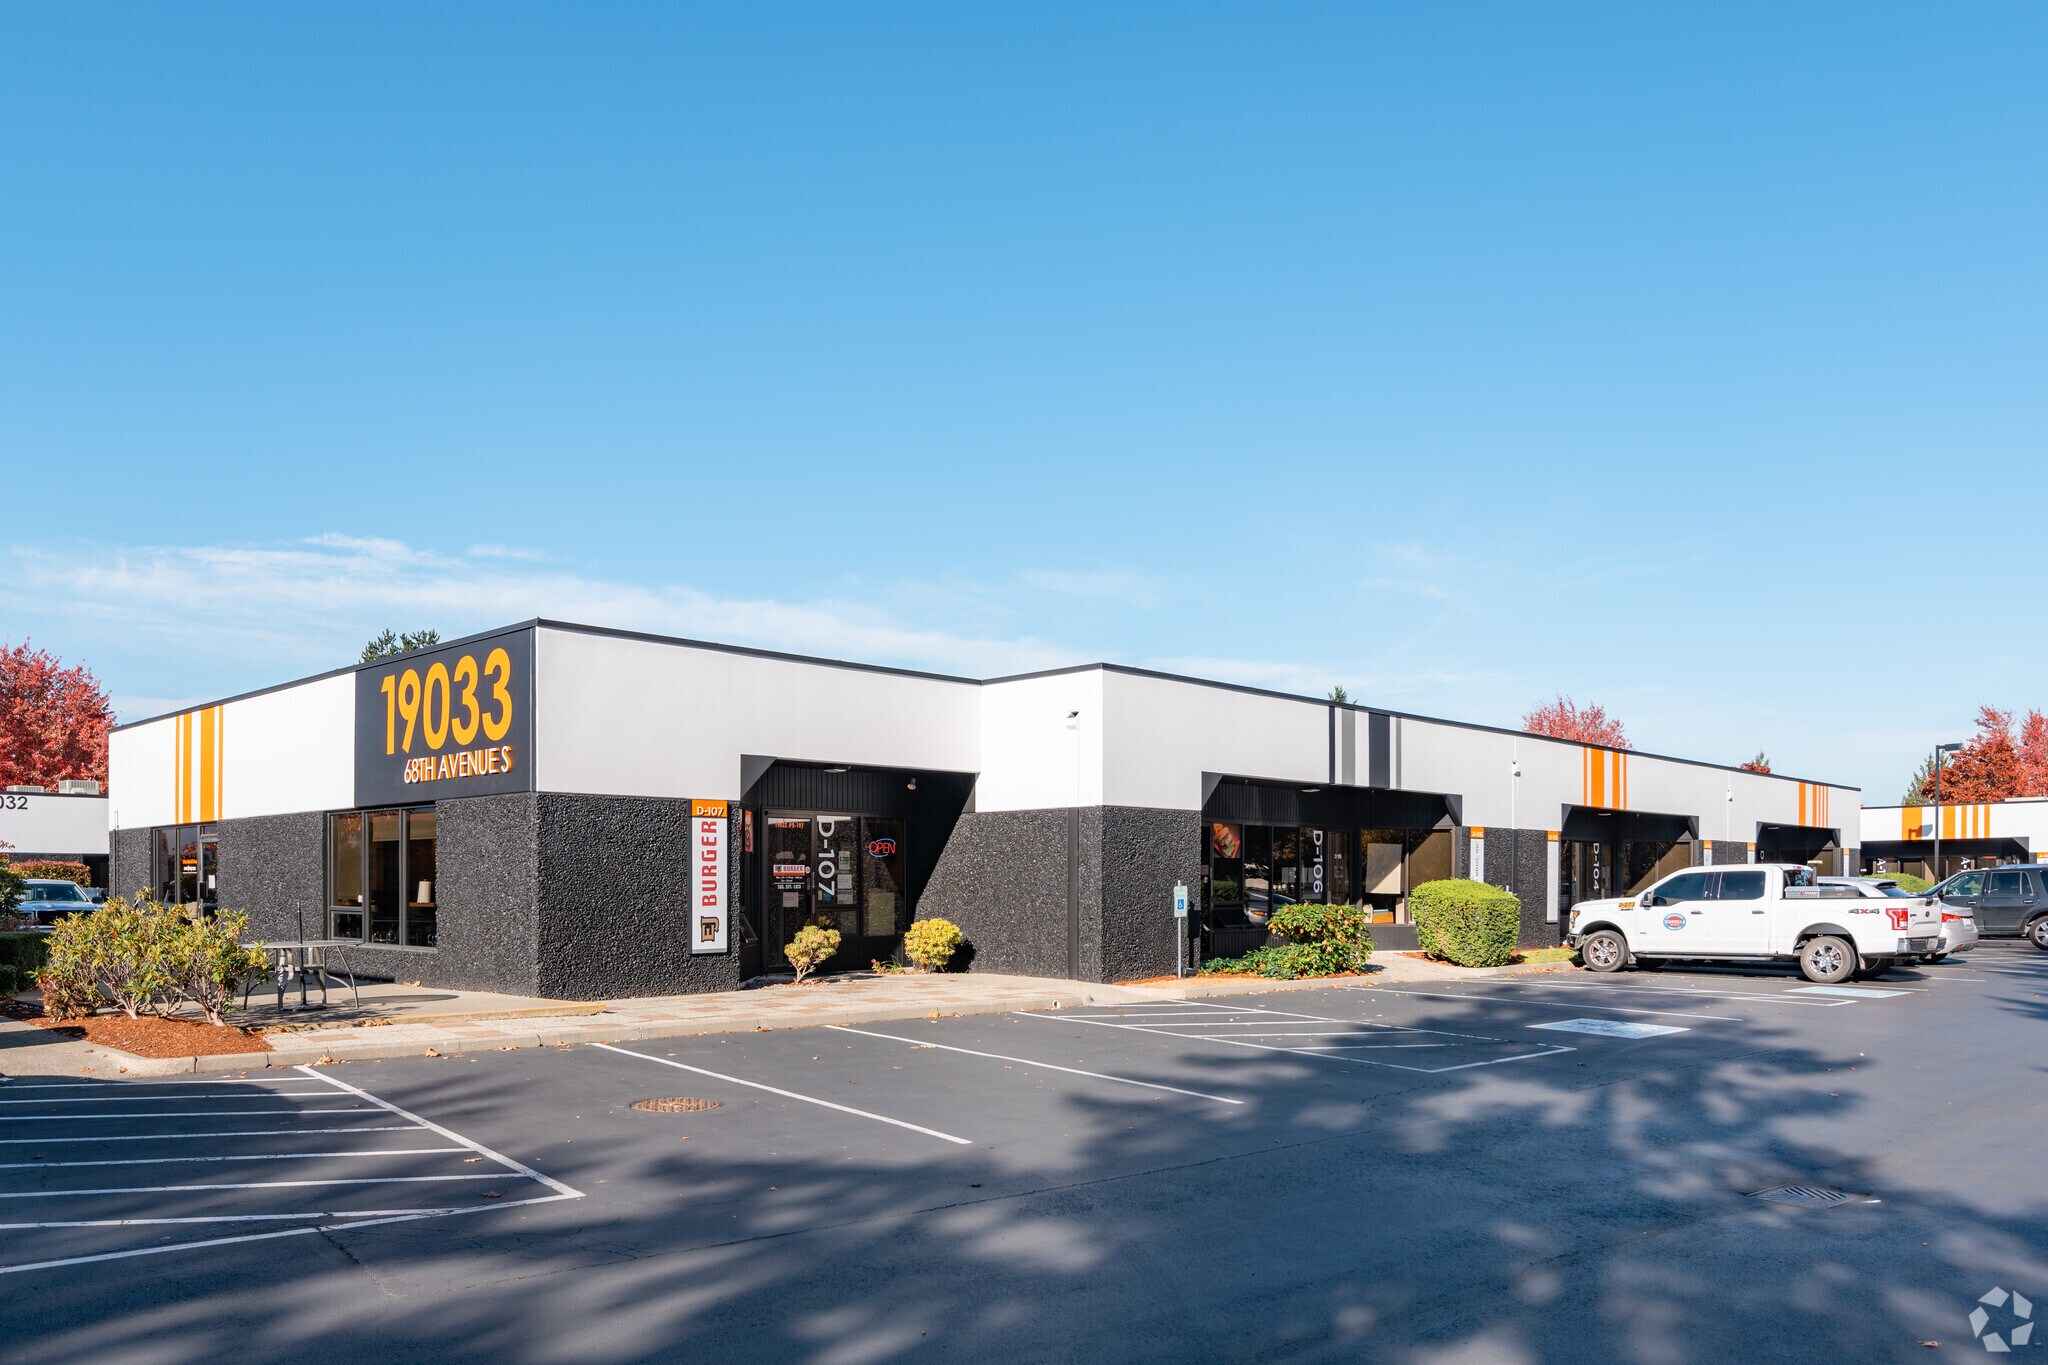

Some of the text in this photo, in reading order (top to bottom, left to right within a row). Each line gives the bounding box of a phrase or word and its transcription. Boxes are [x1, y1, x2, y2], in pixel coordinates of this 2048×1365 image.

[380, 647, 513, 755] 19033
[404, 746, 512, 784] 68TH AVENUE S
[696, 806, 724, 817] D-107
[701, 820, 717, 907] BURGER
[818, 819, 835, 896] D-107
[868, 841, 896, 854] OPEN
[1313, 830, 1323, 894] D-106
